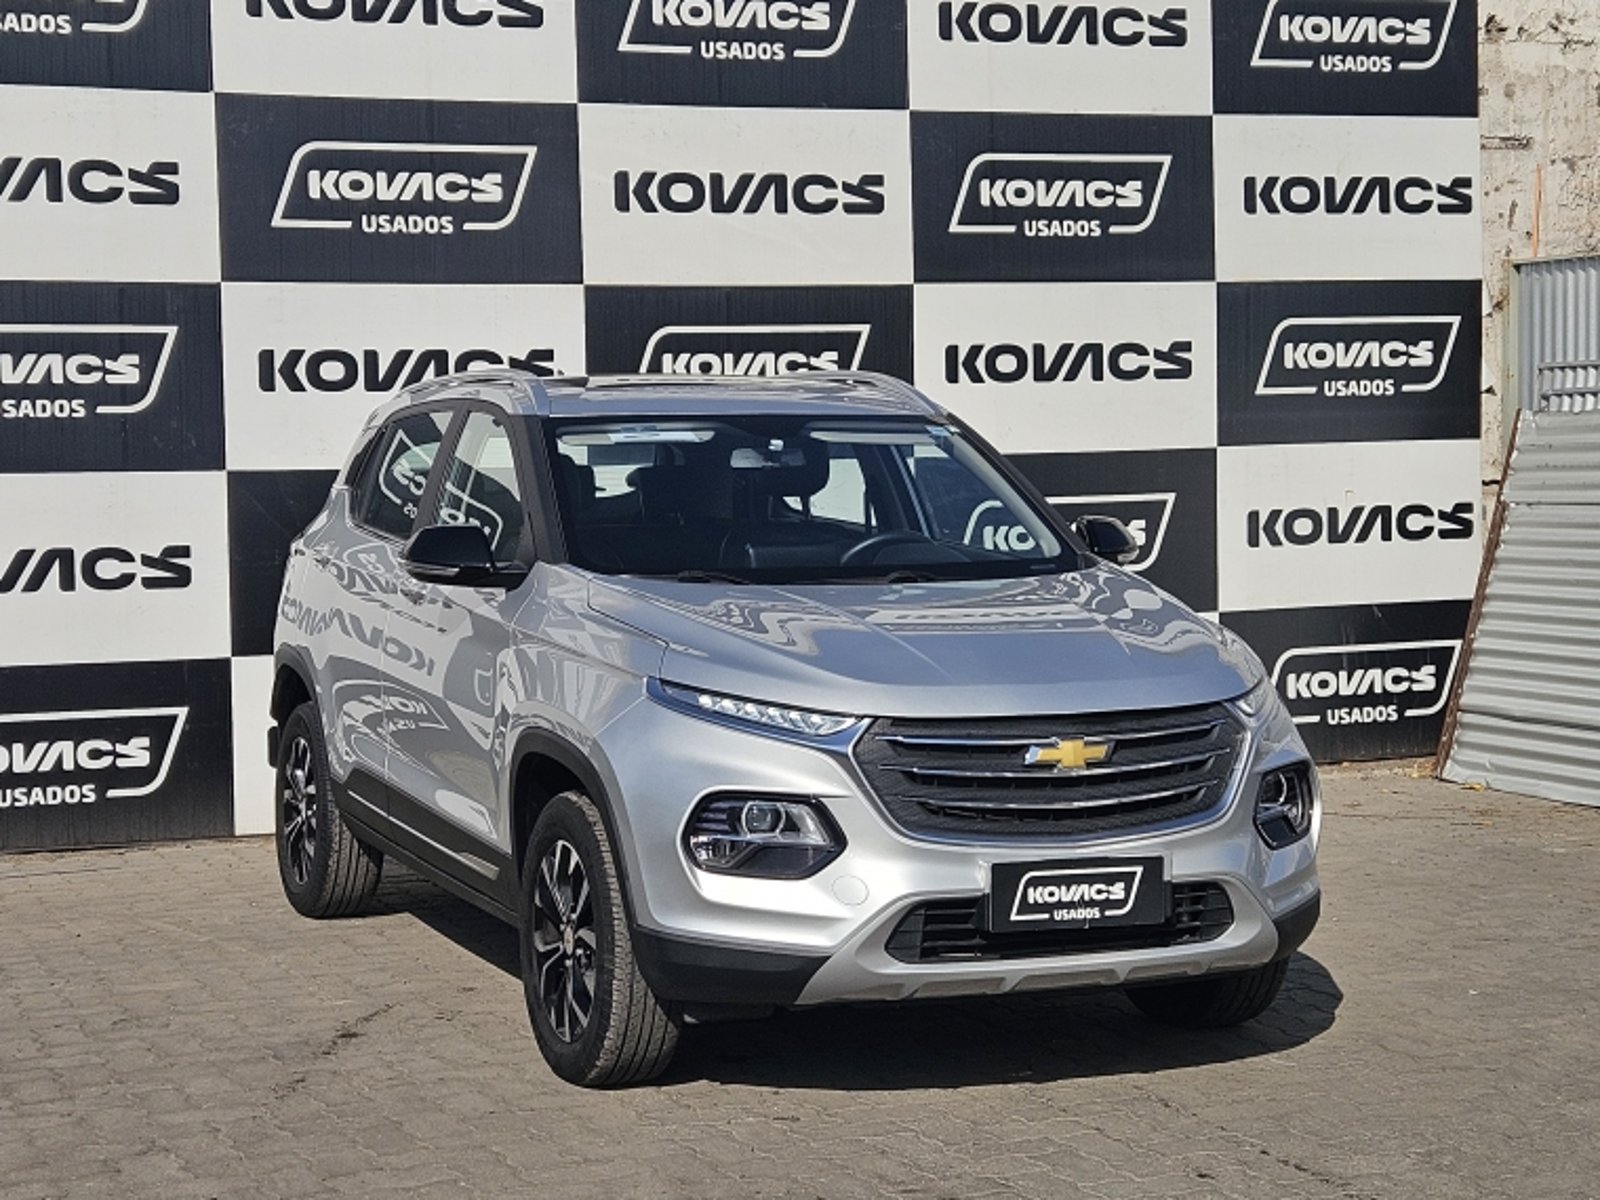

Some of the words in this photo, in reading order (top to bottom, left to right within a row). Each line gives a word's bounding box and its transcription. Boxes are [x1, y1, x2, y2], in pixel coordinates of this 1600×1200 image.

[0, 13, 72, 34] ADOS
[652, 0, 831, 30] KOVACS
[939, 2, 1188, 47] KOVACS
[1280, 15, 1430, 45] KOVACS
[701, 41, 785, 60] USADOS
[1320, 55, 1392, 72] USADOS
[308, 169, 503, 202] KOVACS
[615, 171, 884, 214] KOVACS
[980, 178, 1142, 207] KOVACS
[1244, 176, 1472, 214] KOVACS
[362, 215, 454, 234] USADOS
[1023, 219, 1101, 236] USADOS
[662, 351, 838, 376] KOVACS
[945, 341, 1192, 383] KOVACS
[1284, 341, 1434, 368] KOVACS
[0, 354, 139, 384] VACS
[1324, 379, 1394, 396] USADOS
[2, 400, 86, 418] SADOS
[1247, 502, 1473, 547] KOVACS
[1287, 664, 1436, 699] KOVACS
[1326, 705, 1398, 725] USADOS
[0, 737, 150, 774] VACS
[1027, 882, 1125, 904] KOVACS
[1054, 907, 1101, 920] USADOS
